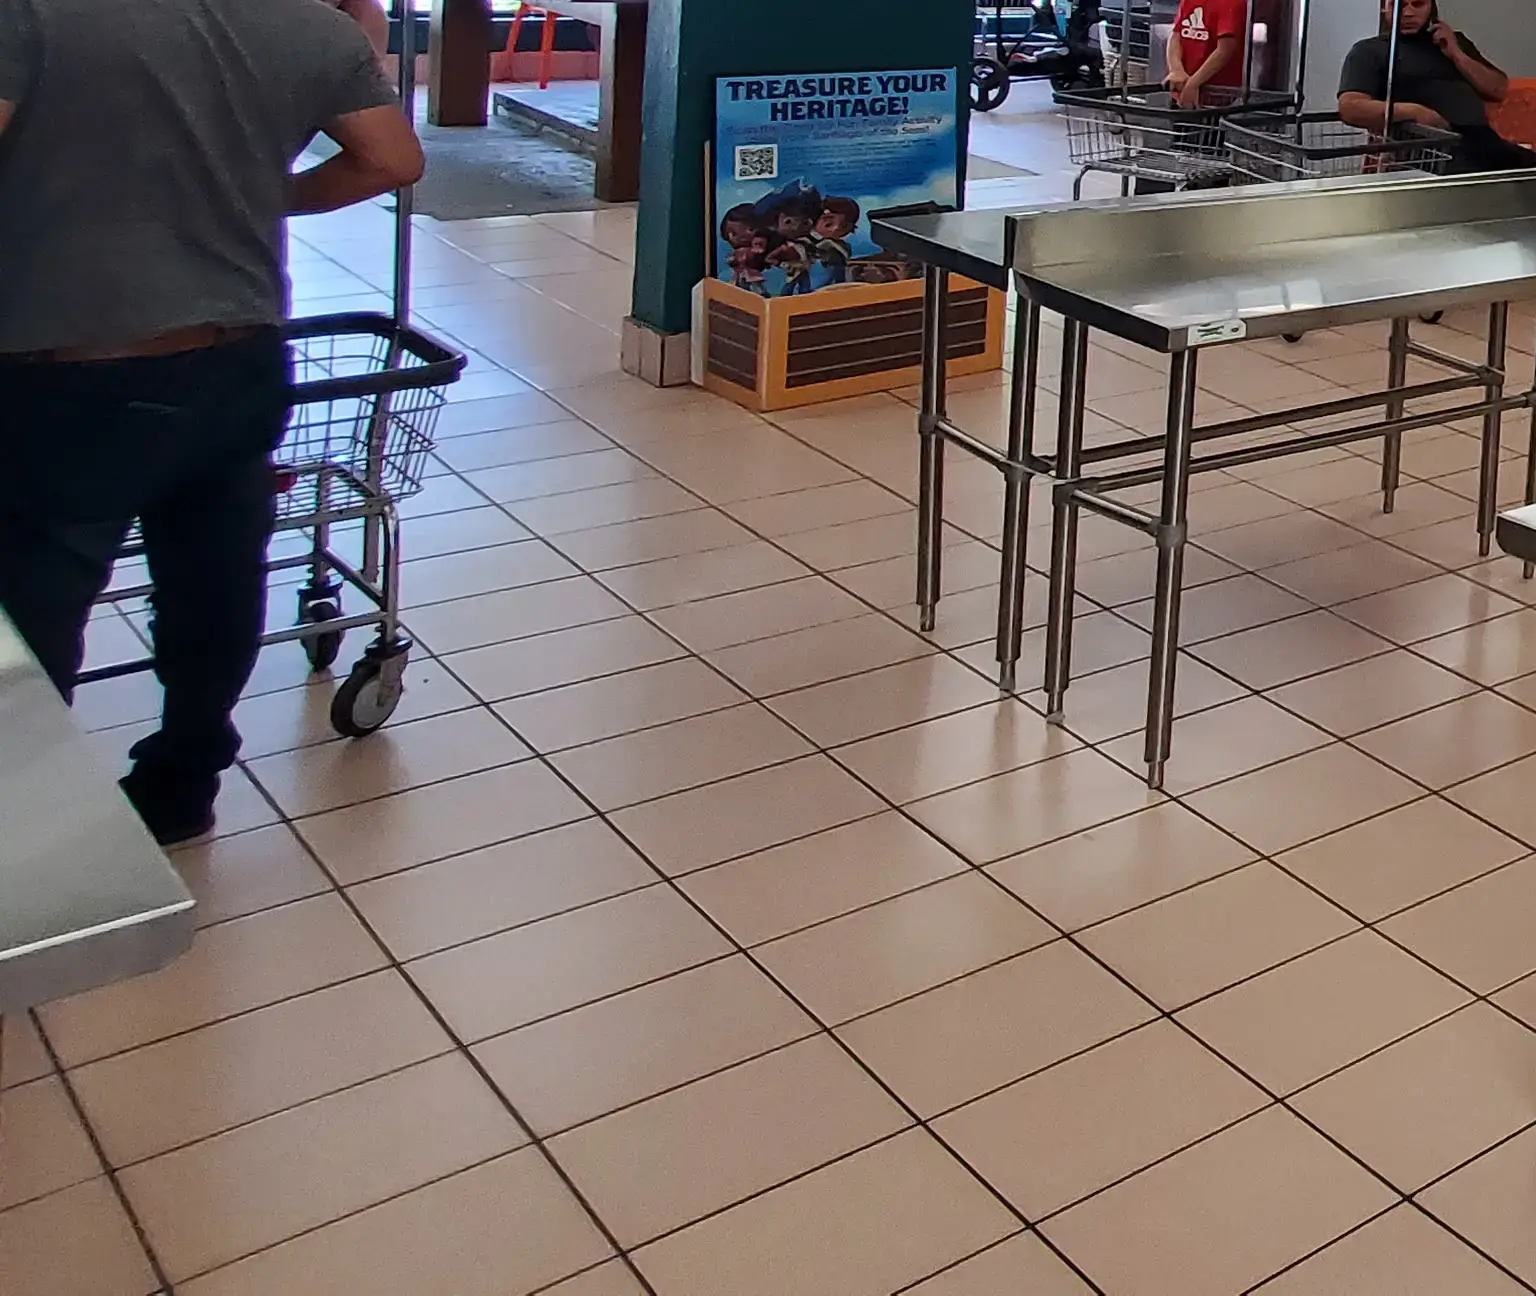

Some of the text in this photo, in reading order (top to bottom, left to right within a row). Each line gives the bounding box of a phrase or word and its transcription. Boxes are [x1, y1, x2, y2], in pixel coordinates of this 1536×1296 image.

[726, 74, 947, 101] TREASURE YOUR
[770, 96, 909, 122] HERITAGE!
